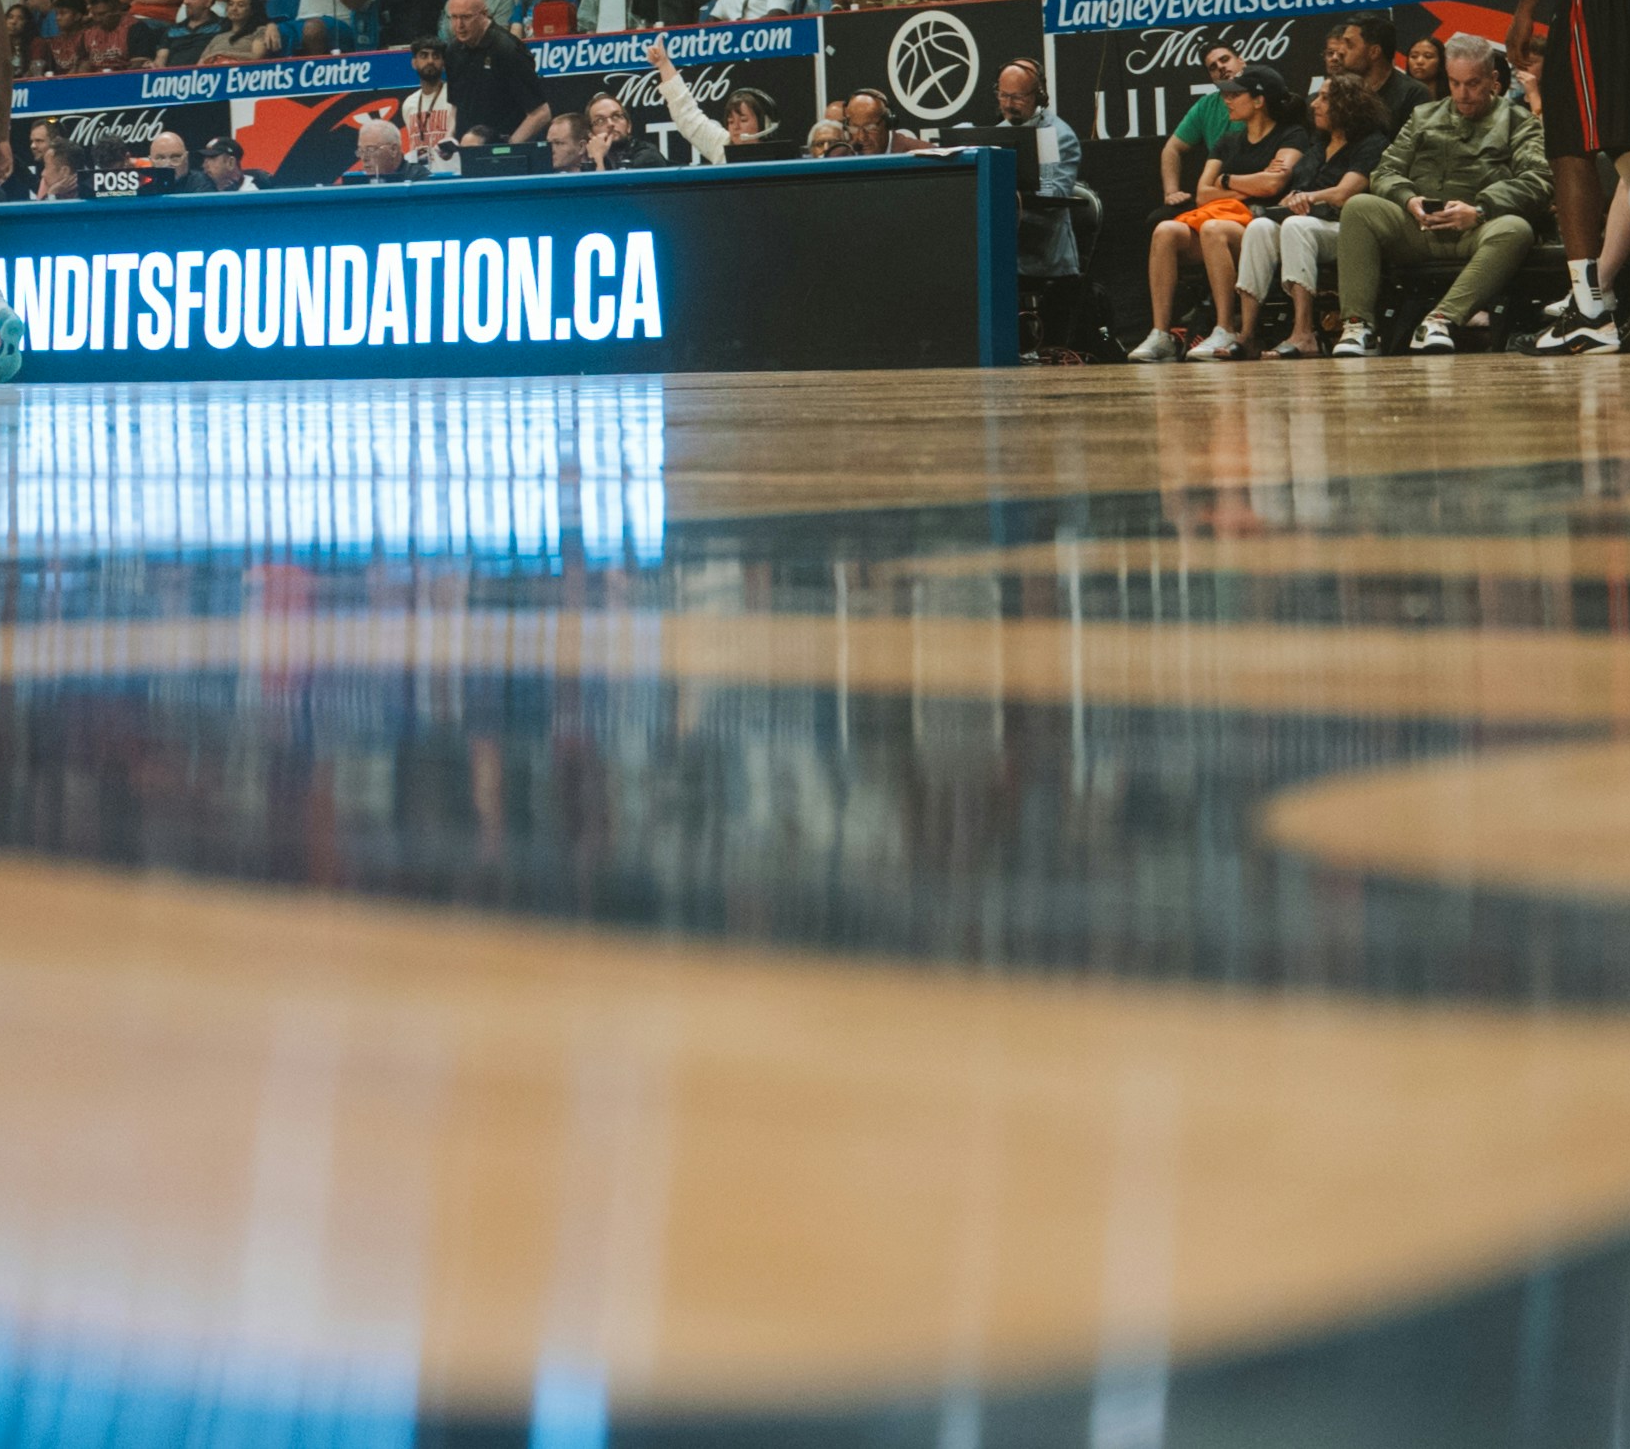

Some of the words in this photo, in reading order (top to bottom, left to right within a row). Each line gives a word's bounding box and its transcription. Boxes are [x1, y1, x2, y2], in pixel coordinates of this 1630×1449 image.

[142, 67, 221, 100] Langley
[226, 62, 294, 93] Events
[299, 58, 371, 88] Centre
[94, 171, 139, 192] POSS
